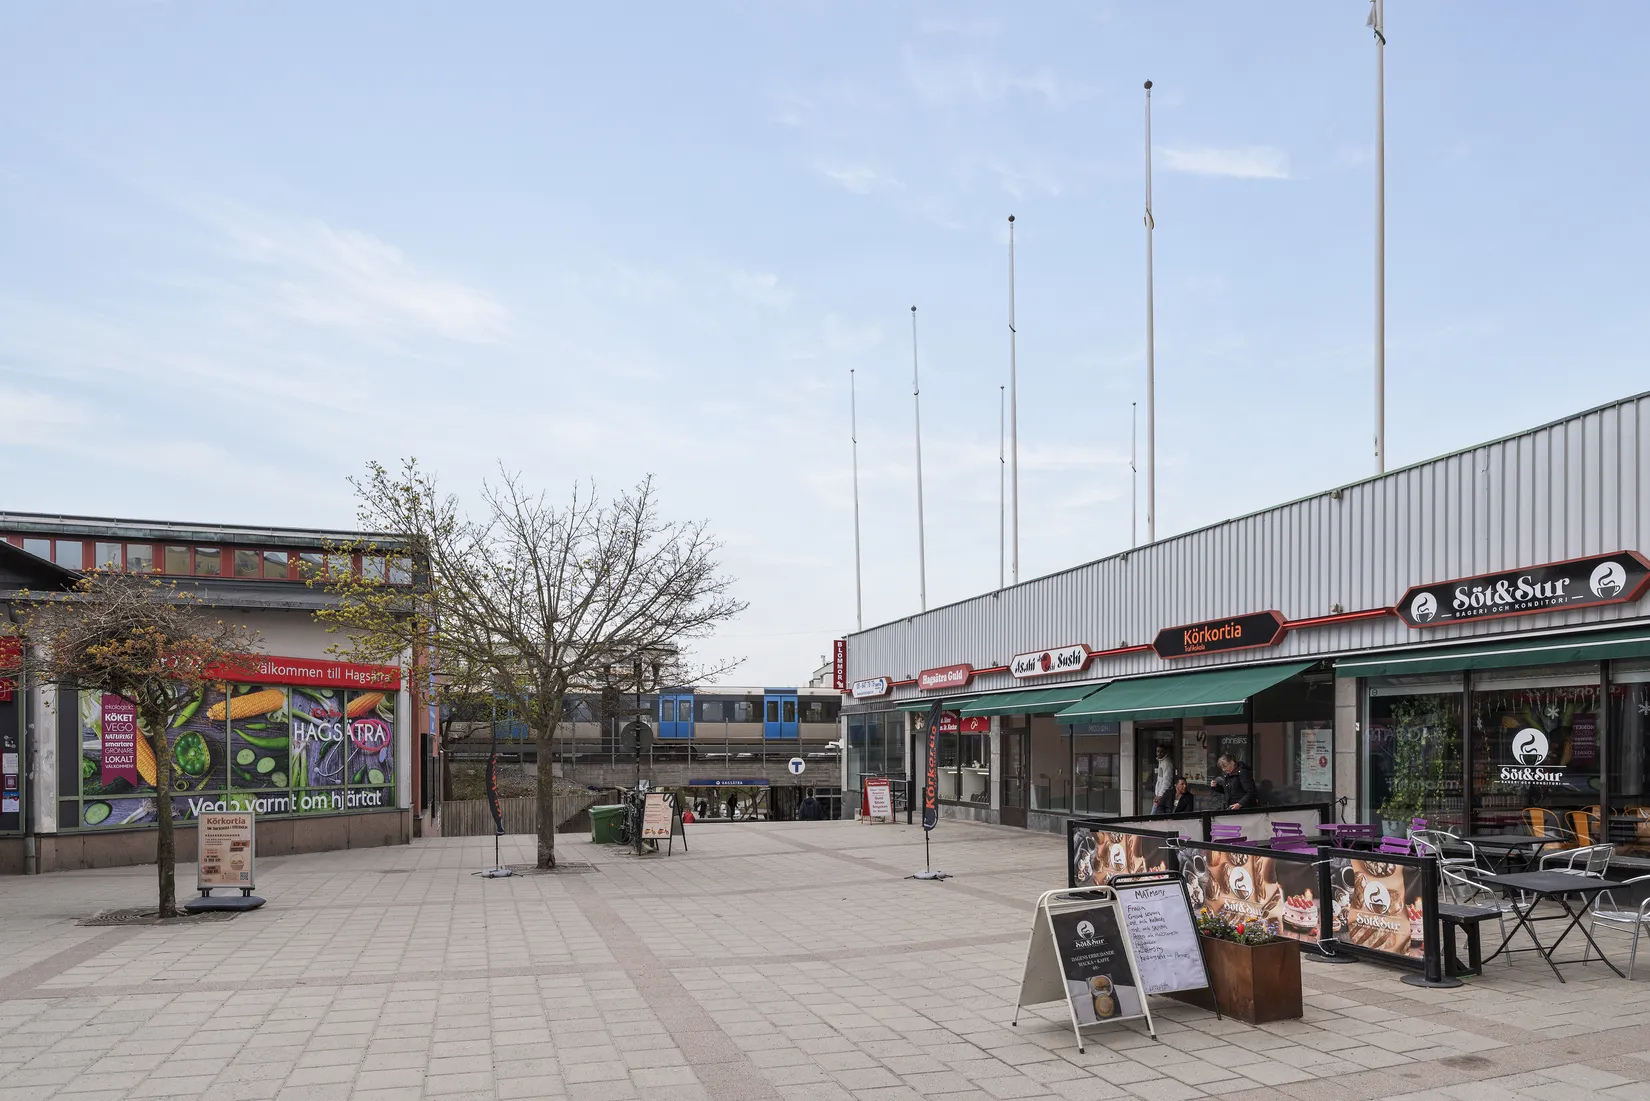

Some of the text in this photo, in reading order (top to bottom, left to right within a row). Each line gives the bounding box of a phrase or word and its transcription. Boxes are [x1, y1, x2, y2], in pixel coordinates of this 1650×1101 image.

[1452, 576, 1570, 610] Söt&Sur
[1456, 609, 1488, 618] BAGERI
[1514, 597, 1568, 609] KONDITORI
[1184, 622, 1242, 645] Körkortia
[1015, 658, 1035, 673] Asahi
[1058, 650, 1080, 668] Sushi
[327, 667, 340, 679] till
[923, 670, 963, 686] Hagsätra Guld
[105, 713, 134, 721] KÖKET
[105, 723, 134, 731] VEGO
[294, 719, 386, 741] HAGSÄTRA
[1500, 767, 1563, 782] Söt&Sur
[245, 794, 297, 814] varmt
[301, 795, 327, 810] om
[331, 790, 382, 811] hjärtat
[1224, 899, 1262, 916] Söt&Sur
[1356, 913, 1400, 930] Söt&Sur
